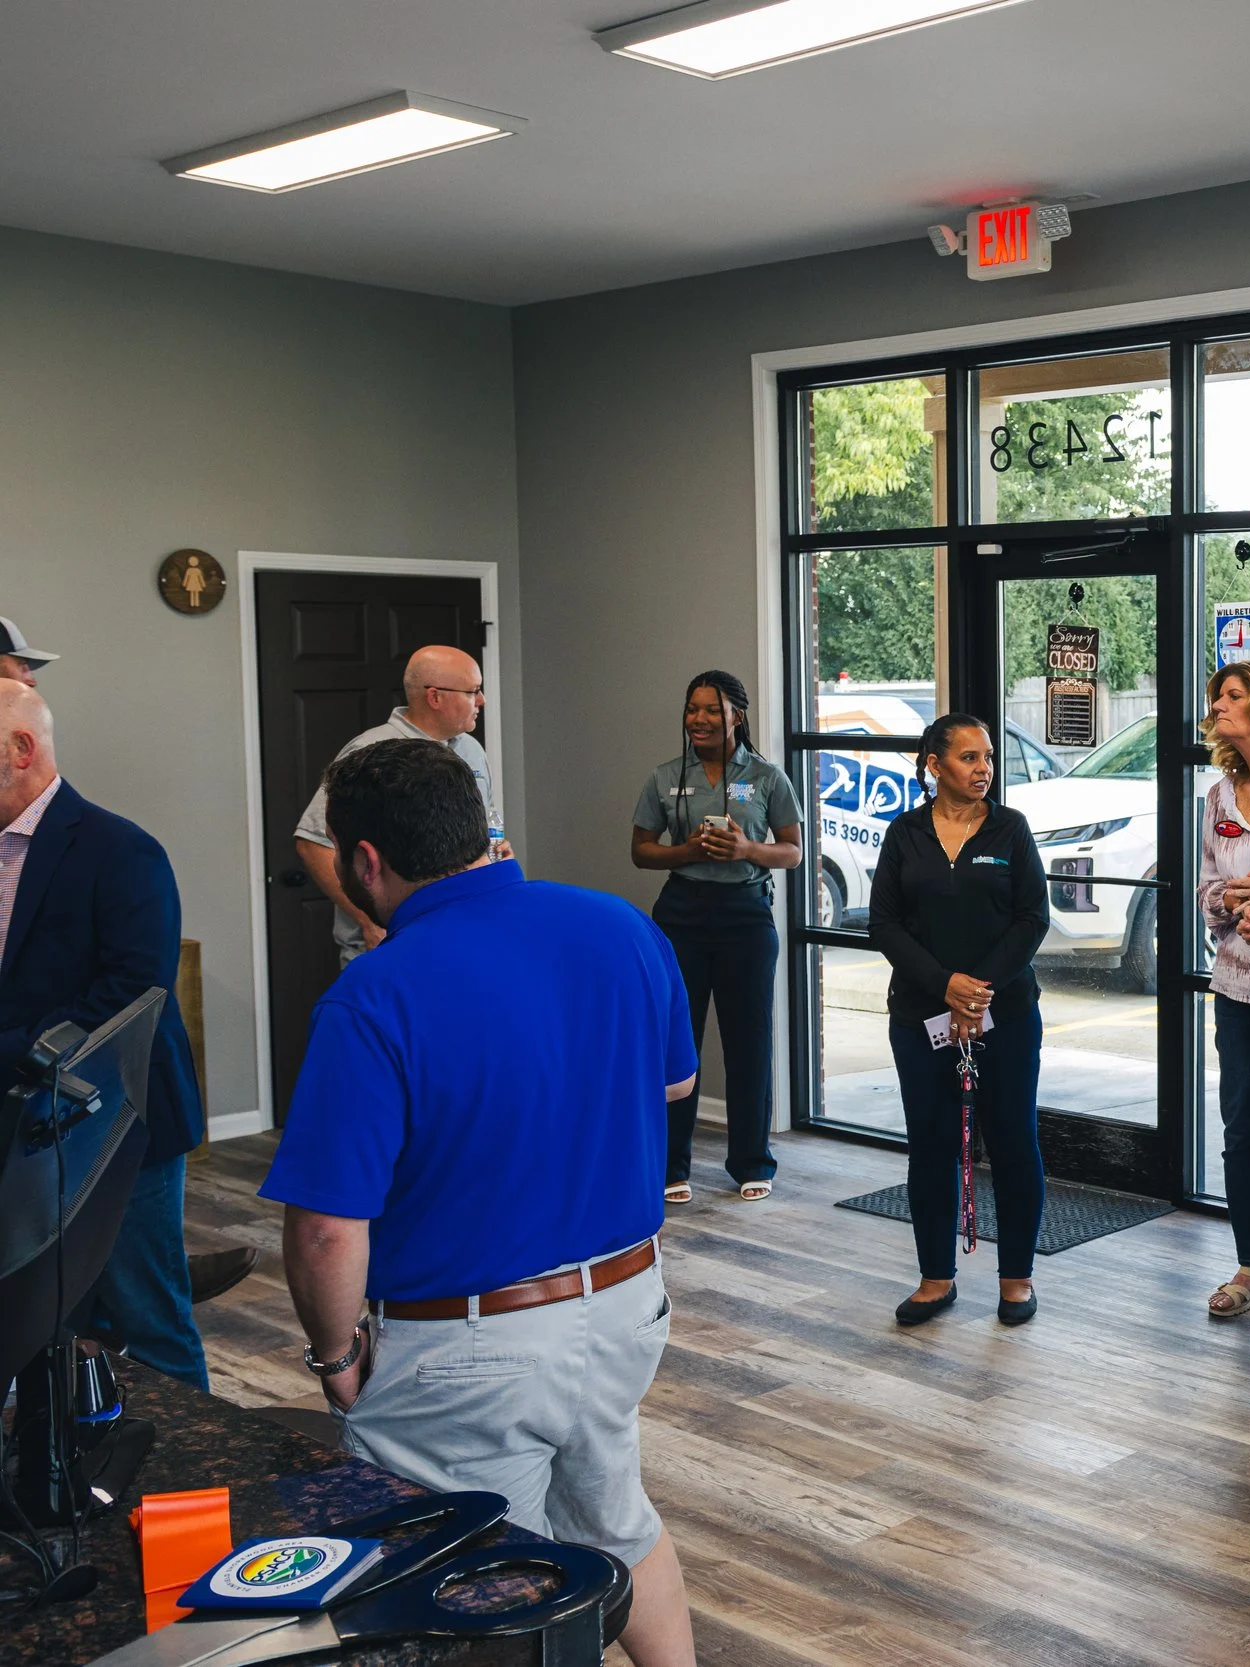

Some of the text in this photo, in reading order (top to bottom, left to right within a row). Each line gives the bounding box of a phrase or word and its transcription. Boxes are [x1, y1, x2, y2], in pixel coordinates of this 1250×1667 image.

[978, 206, 1031, 267] EXIT
[1216, 608, 1233, 616] WILL
[1049, 626, 1096, 652] Sorry
[1049, 651, 1097, 672] CLOSED
[823, 818, 883, 848] 15 390 9
[251, 1549, 299, 1582] PSACC
[275, 1570, 321, 1590] CHAMBER
